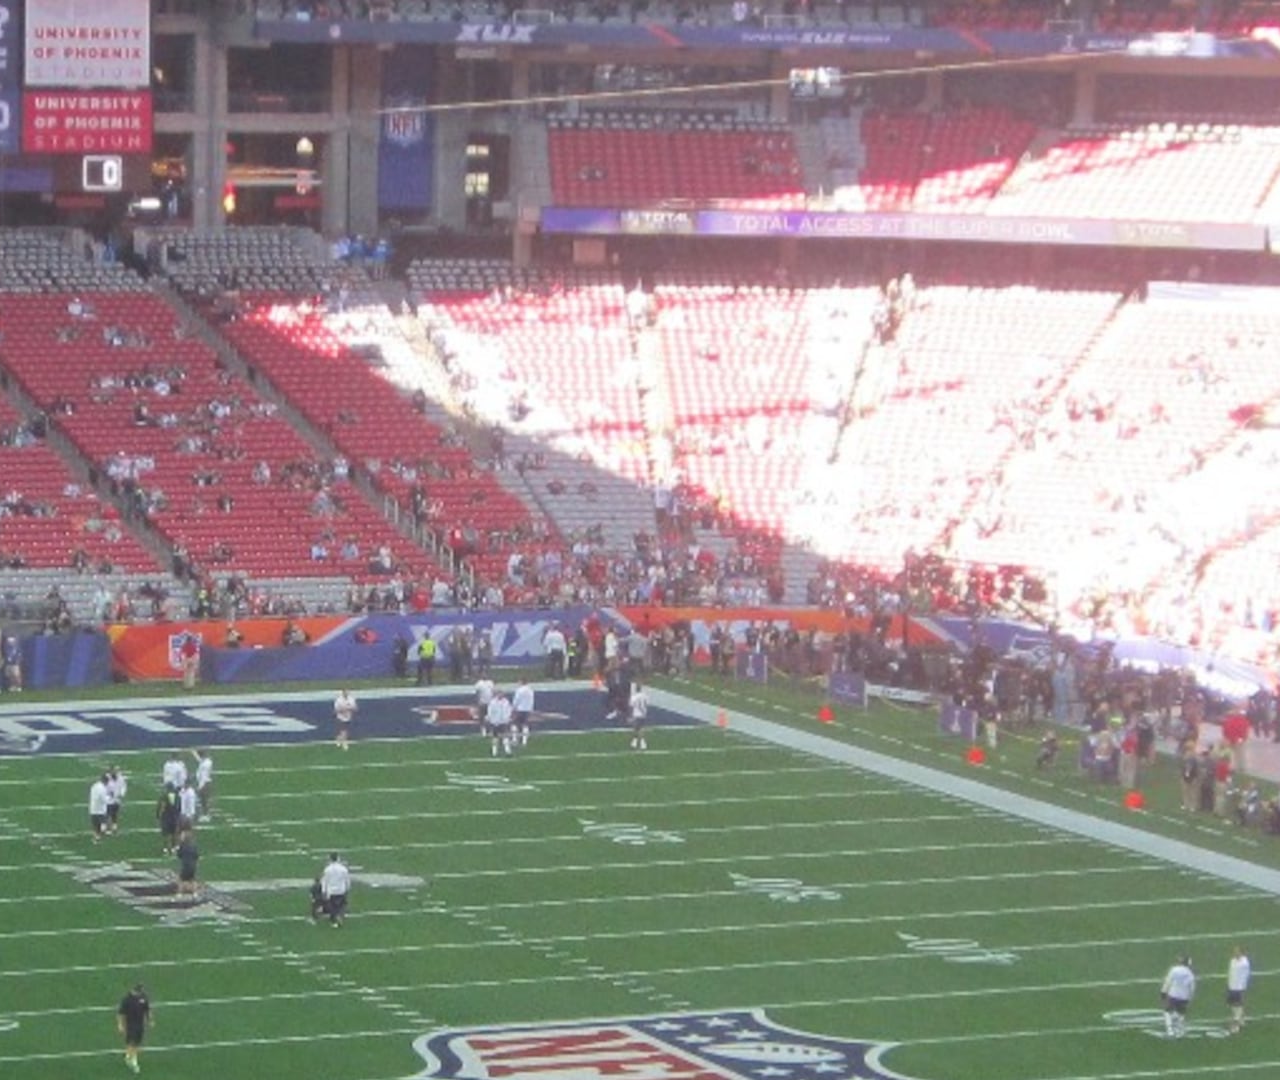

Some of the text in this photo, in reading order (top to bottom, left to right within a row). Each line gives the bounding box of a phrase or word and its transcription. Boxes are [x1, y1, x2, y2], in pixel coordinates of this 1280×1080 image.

[34, 27, 142, 39] UNIVERSITY
[455, 24, 537, 43] XLIX
[33, 47, 141, 58] OF PHOENIX
[34, 96, 141, 109] UNIVERSITY
[34, 115, 141, 129] OF PHOENIX
[35, 134, 141, 148] STADIUM
[102, 159, 119, 186] 0
[733, 215, 792, 231] TOTAL
[799, 216, 871, 233] ACCESS
[879, 217, 905, 233] AT
